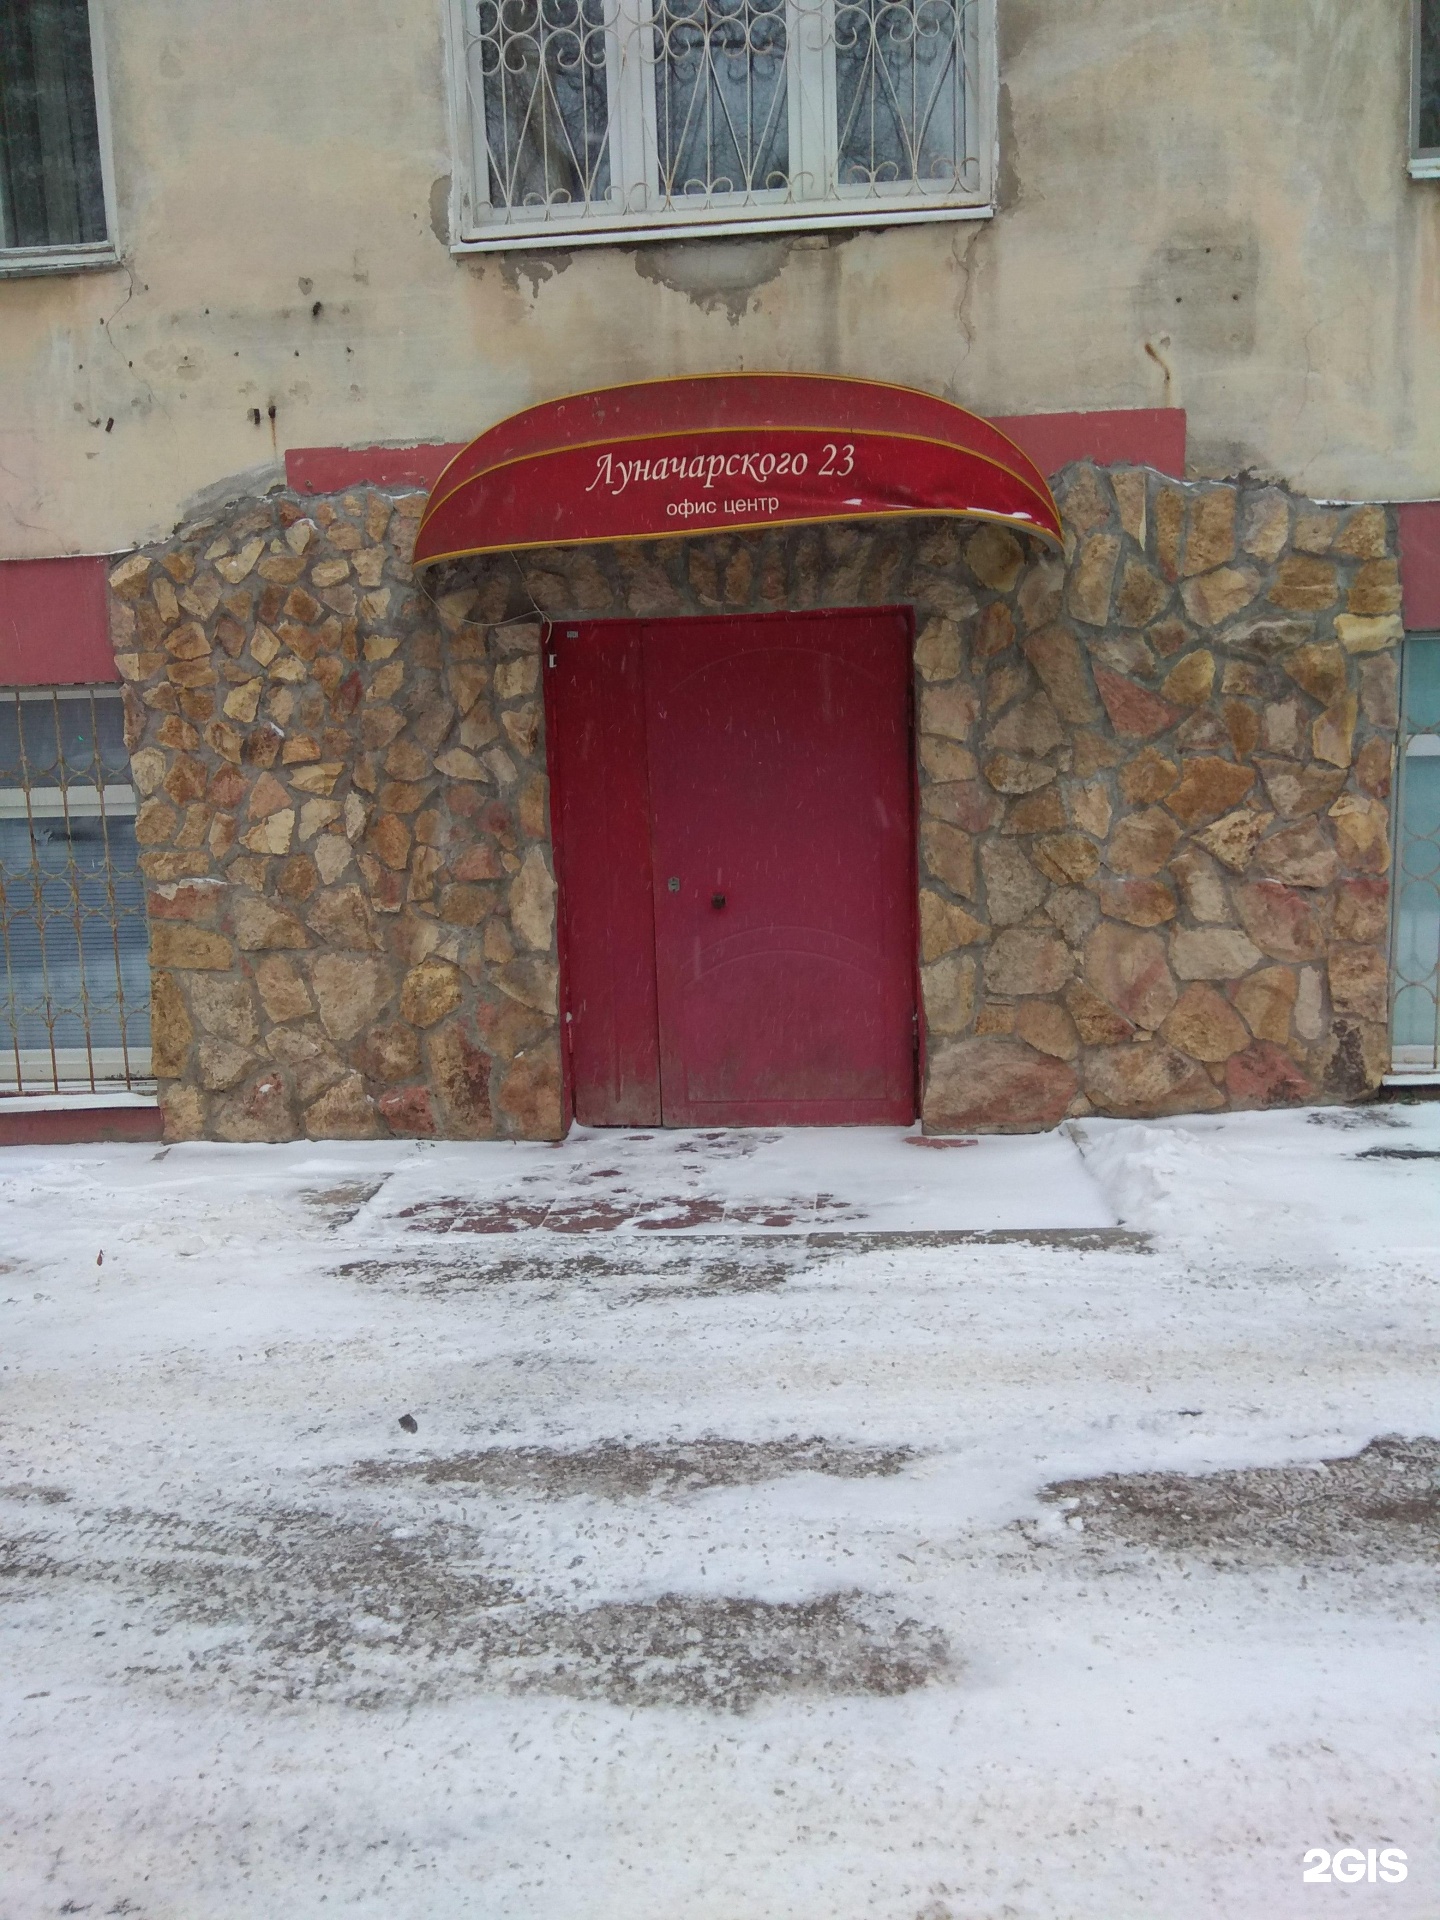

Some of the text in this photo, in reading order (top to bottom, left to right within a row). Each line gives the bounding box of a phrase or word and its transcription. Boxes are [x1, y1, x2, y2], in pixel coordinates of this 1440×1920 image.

[585, 443, 855, 495] Луначарского 23
[666, 496, 779, 518] офис центр
